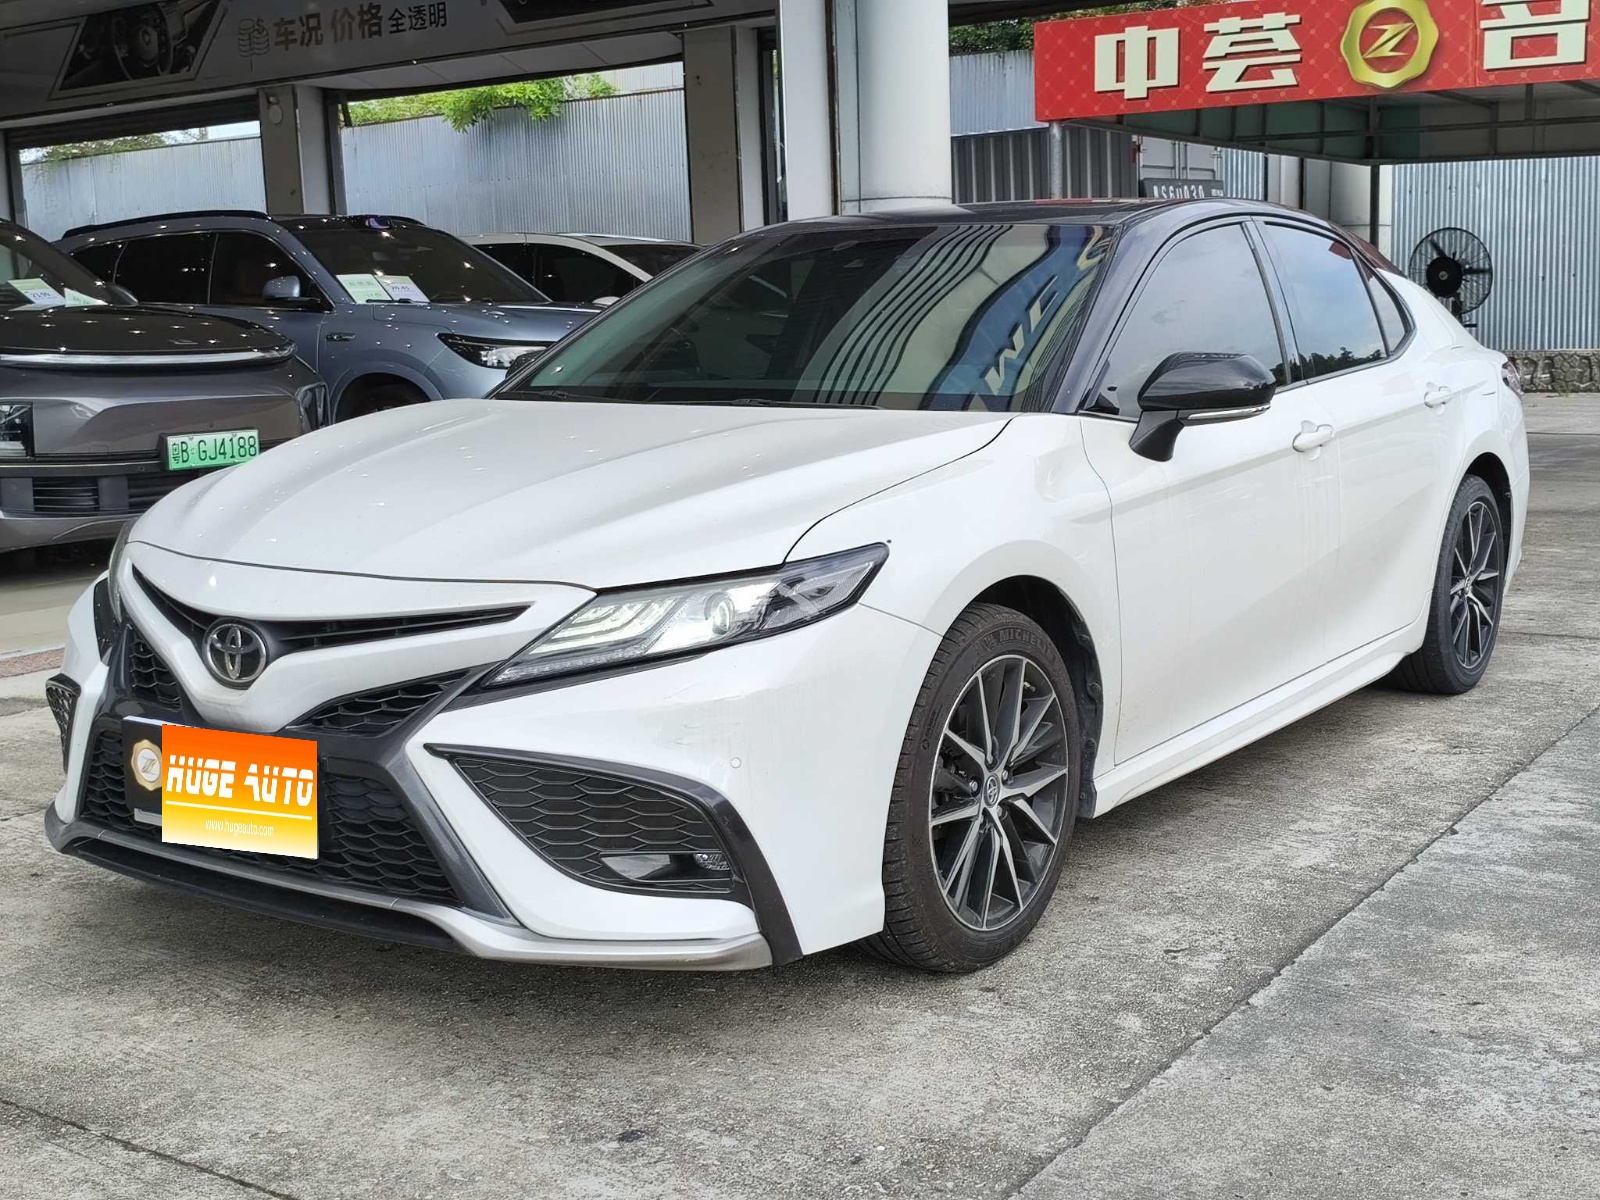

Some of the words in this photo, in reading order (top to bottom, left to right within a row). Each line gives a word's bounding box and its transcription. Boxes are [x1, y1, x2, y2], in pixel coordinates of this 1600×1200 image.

[273, 12, 324, 51] 车况
[330, 2, 383, 43] 价格
[388, 1, 448, 35] 全透明
